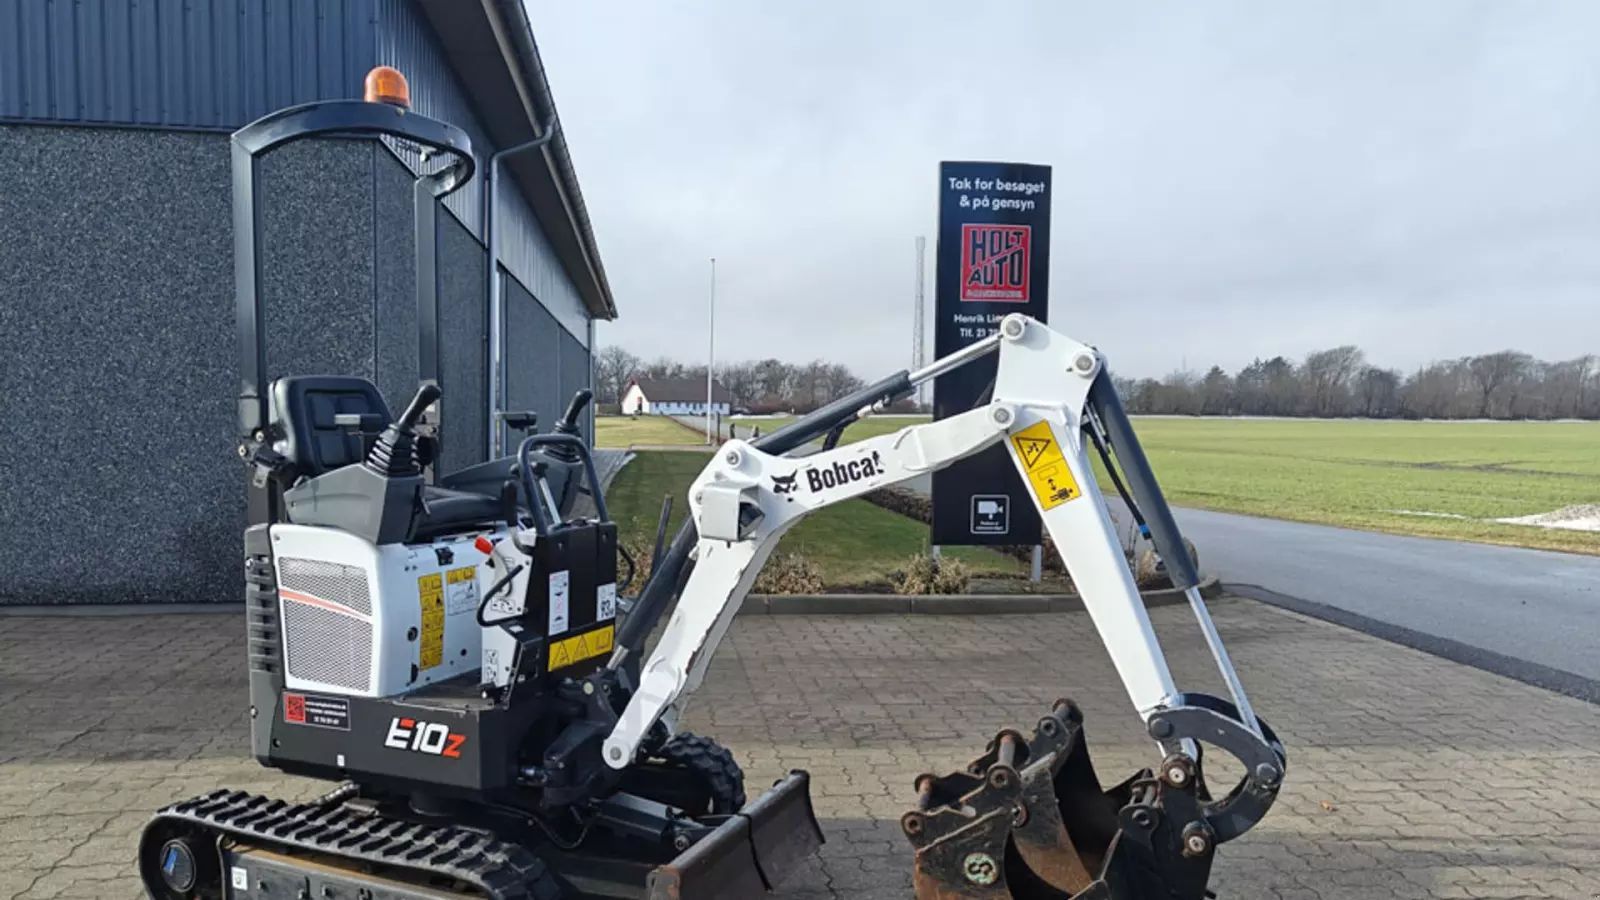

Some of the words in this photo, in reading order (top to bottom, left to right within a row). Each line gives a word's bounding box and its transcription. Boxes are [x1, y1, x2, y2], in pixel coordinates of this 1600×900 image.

[948, 177, 972, 190] Tak
[974, 178, 993, 190] for
[996, 178, 1046, 195] besøget
[959, 194, 970, 208] &
[972, 195, 990, 210] på
[991, 198, 1035, 212] gensyn
[967, 248, 1025, 287] AUTO
[953, 313, 985, 323] Henrik
[805, 450, 885, 494] Bobcat
